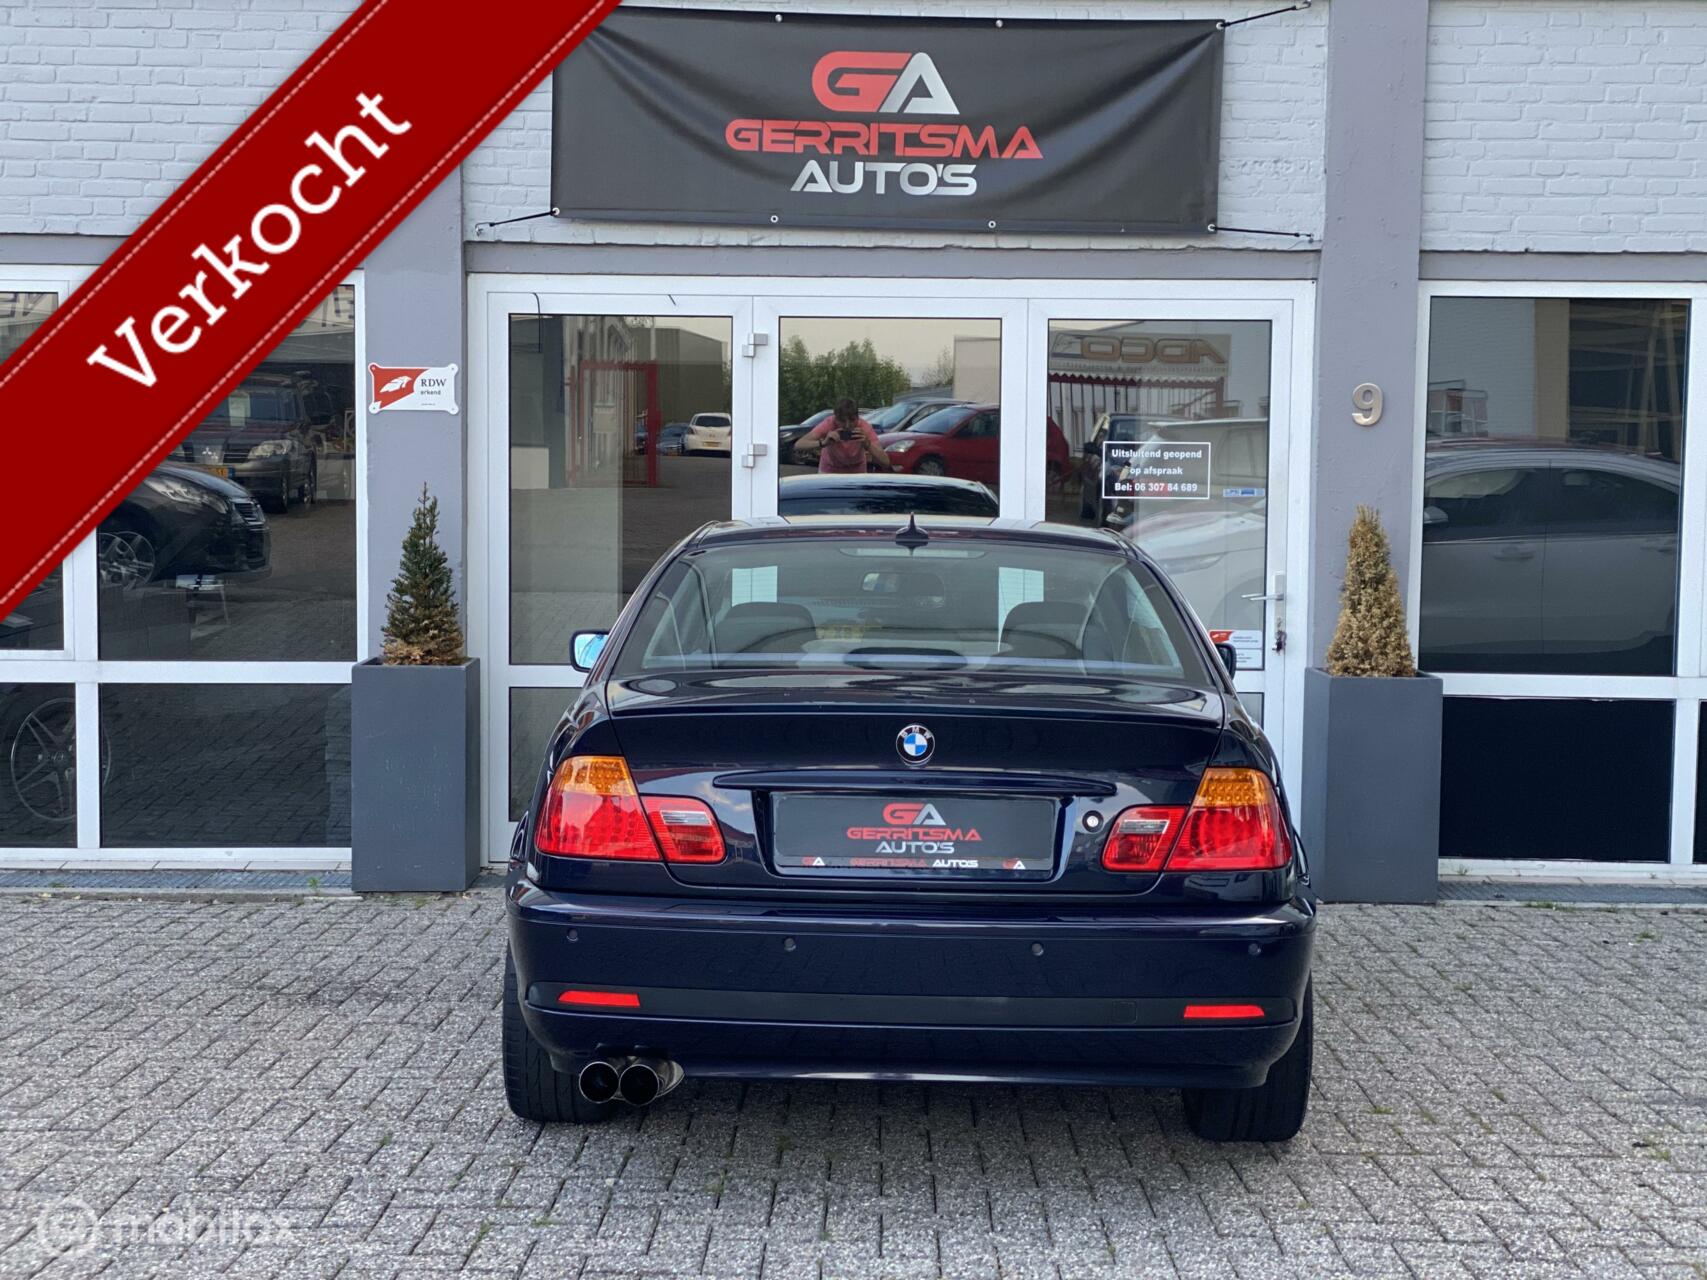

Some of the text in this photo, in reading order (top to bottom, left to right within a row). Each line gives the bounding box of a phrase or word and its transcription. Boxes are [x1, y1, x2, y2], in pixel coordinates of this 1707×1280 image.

[811, 50, 960, 115] GA
[725, 118, 1044, 160] GERRITSMA
[790, 159, 978, 196] AUTO'S
[421, 378, 446, 387] RDW
[1352, 382, 1383, 427] 9
[1111, 448, 1203, 460] Uitsluitend geopend
[1129, 466, 1184, 477] op afspraak
[1114, 482, 1133, 492] Bel:
[1134, 482, 1146, 492] 06
[1148, 482, 1165, 492] 307
[1180, 483, 1198, 492] 689
[882, 802, 947, 826] GA
[847, 827, 983, 841] GERRITSMA
[875, 840, 955, 854] AUTO'S
